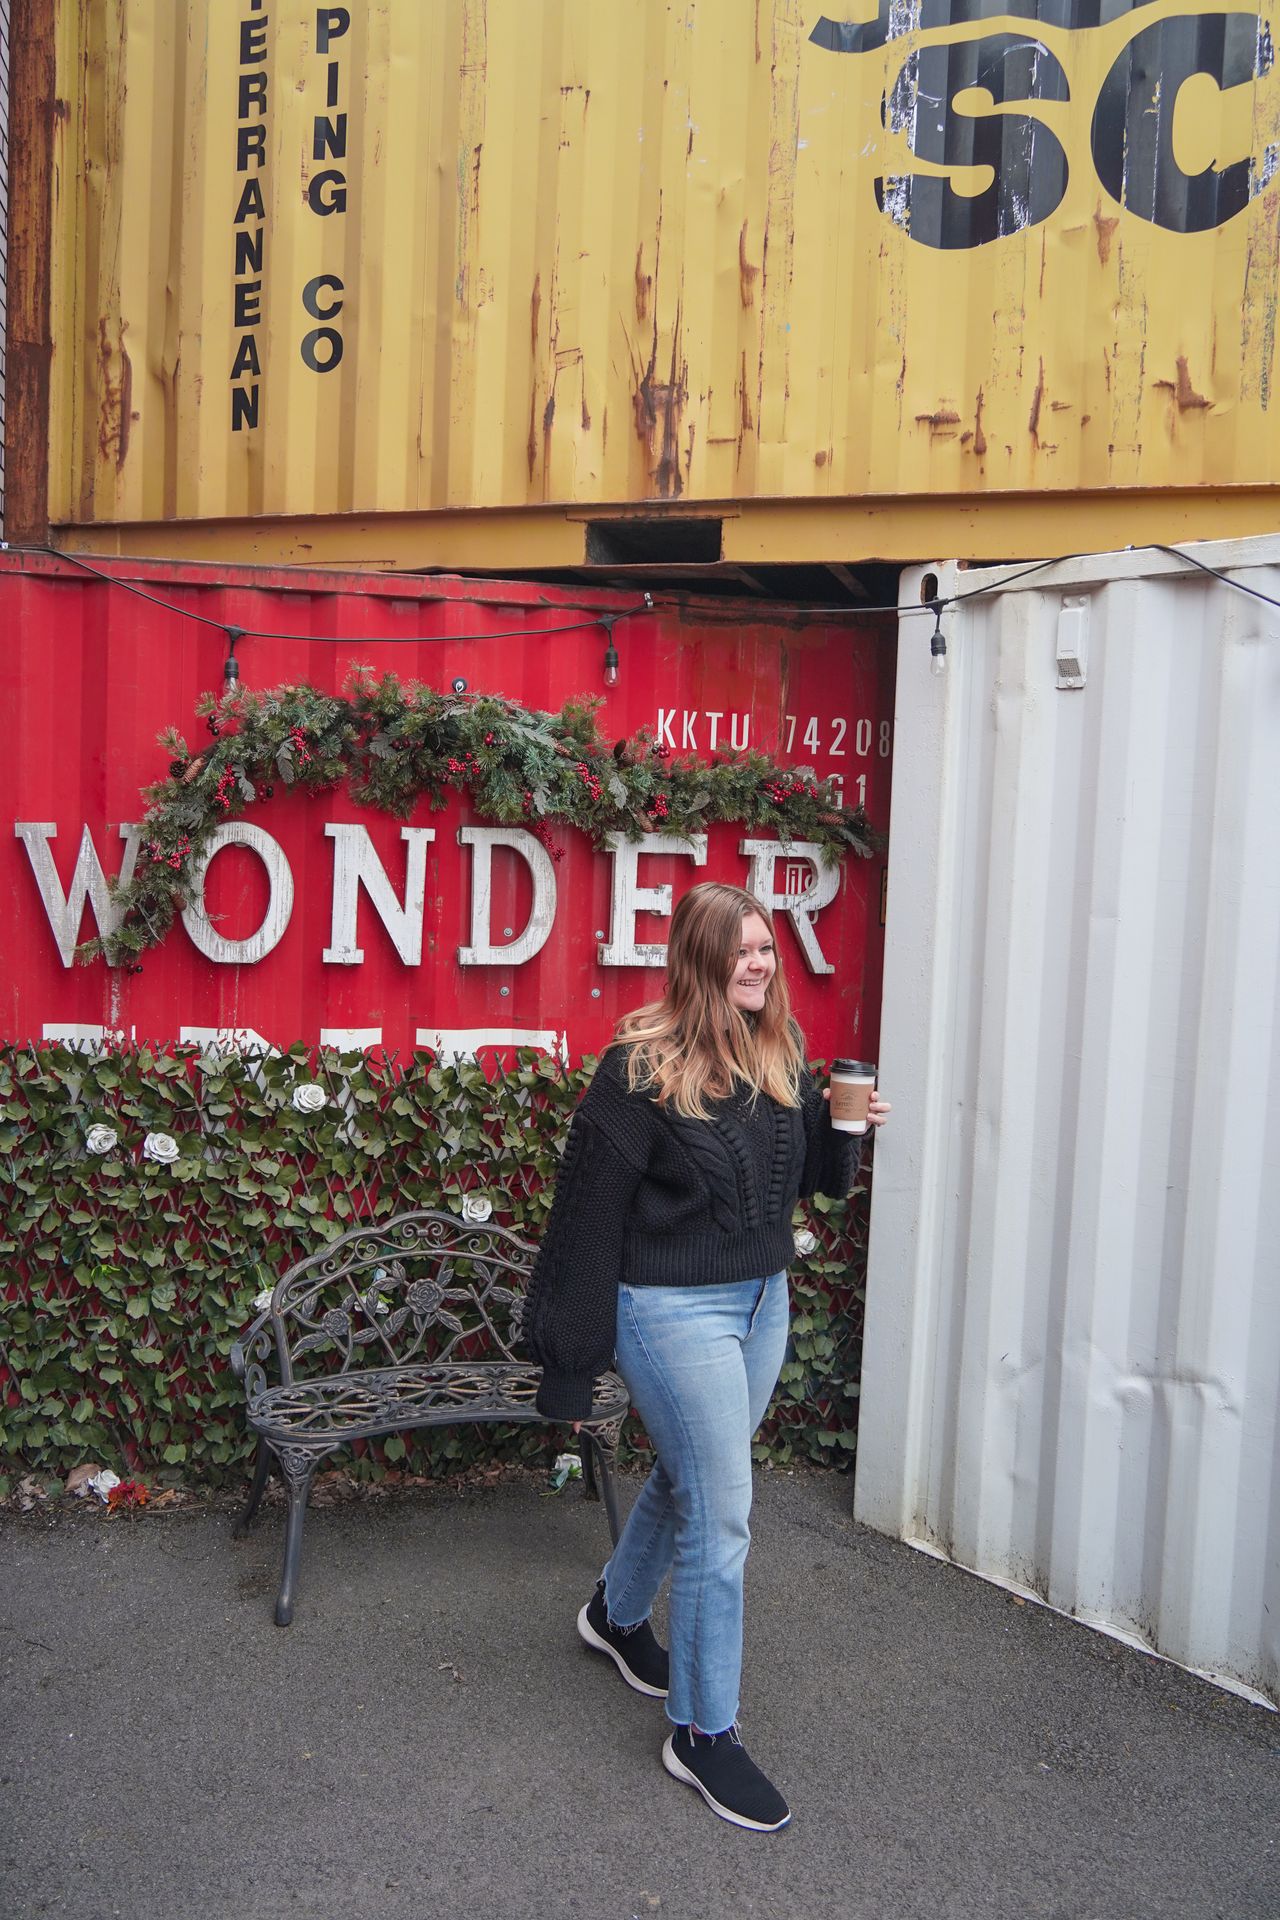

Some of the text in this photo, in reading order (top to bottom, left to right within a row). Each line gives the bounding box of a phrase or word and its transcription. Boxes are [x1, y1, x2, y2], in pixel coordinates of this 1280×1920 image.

[230, 0, 268, 431] ERRANEAN
[301, 274, 345, 373] CO
[657, 708, 891, 758] KKTU 74208
[14, 820, 841, 975] WONDER
